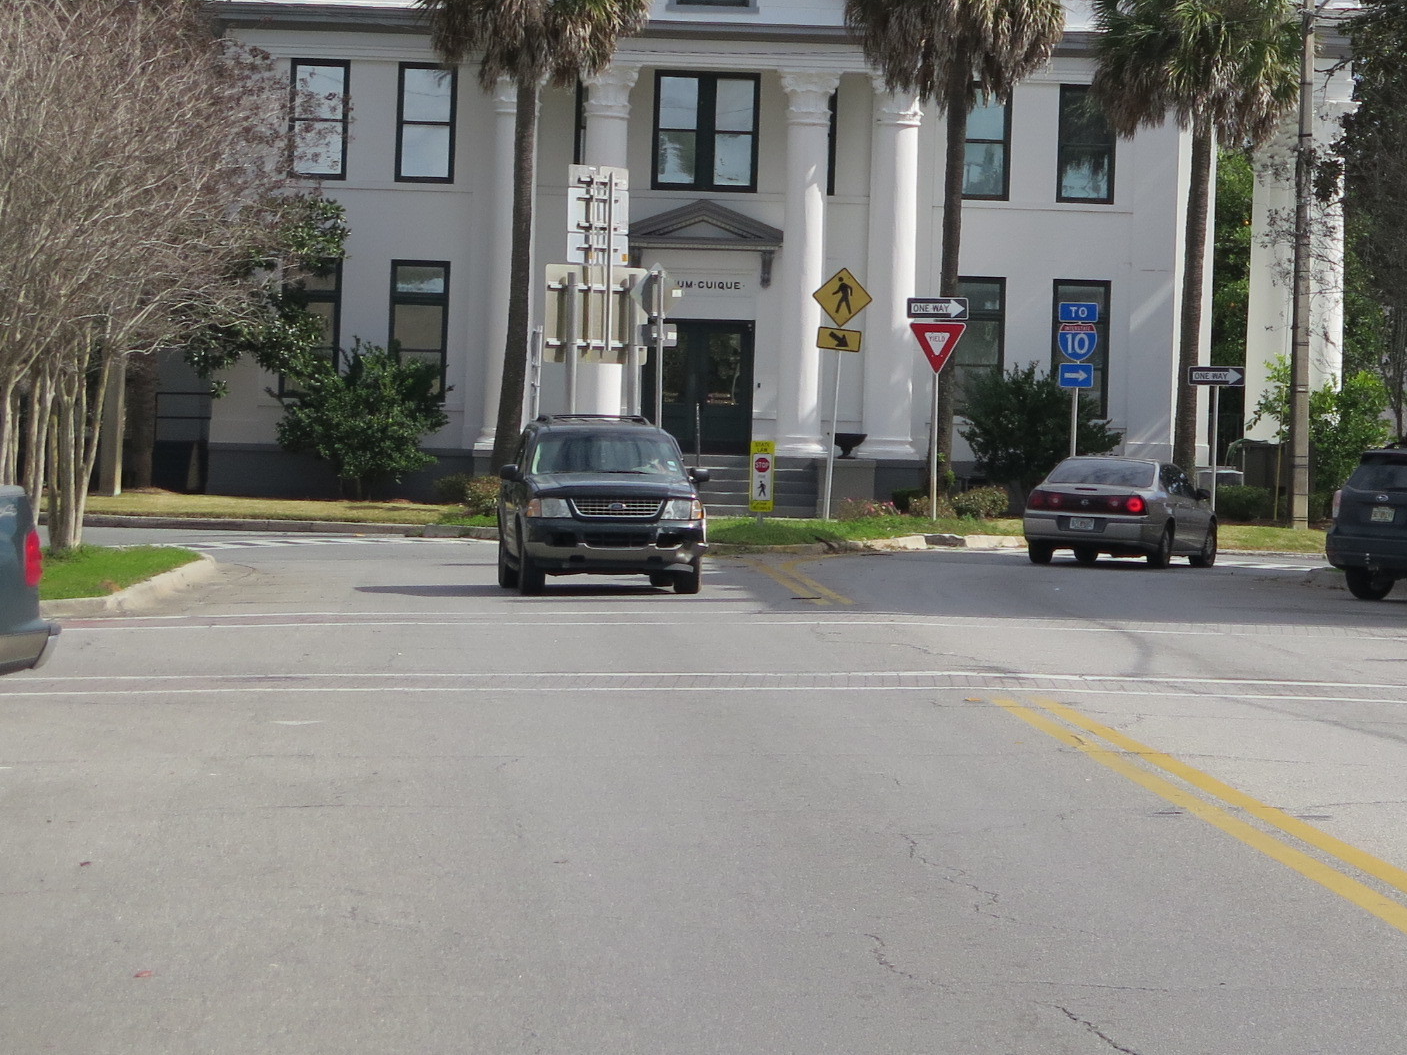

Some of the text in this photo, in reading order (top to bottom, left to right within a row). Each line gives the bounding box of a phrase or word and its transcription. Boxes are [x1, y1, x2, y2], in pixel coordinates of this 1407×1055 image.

[912, 304, 950, 313] ONE WAY
[1069, 306, 1088, 318] TO
[928, 335, 946, 343] YIELD
[1065, 333, 1089, 355] 10
[1194, 372, 1228, 380] ONE WAY
[755, 461, 769, 469] STOP
